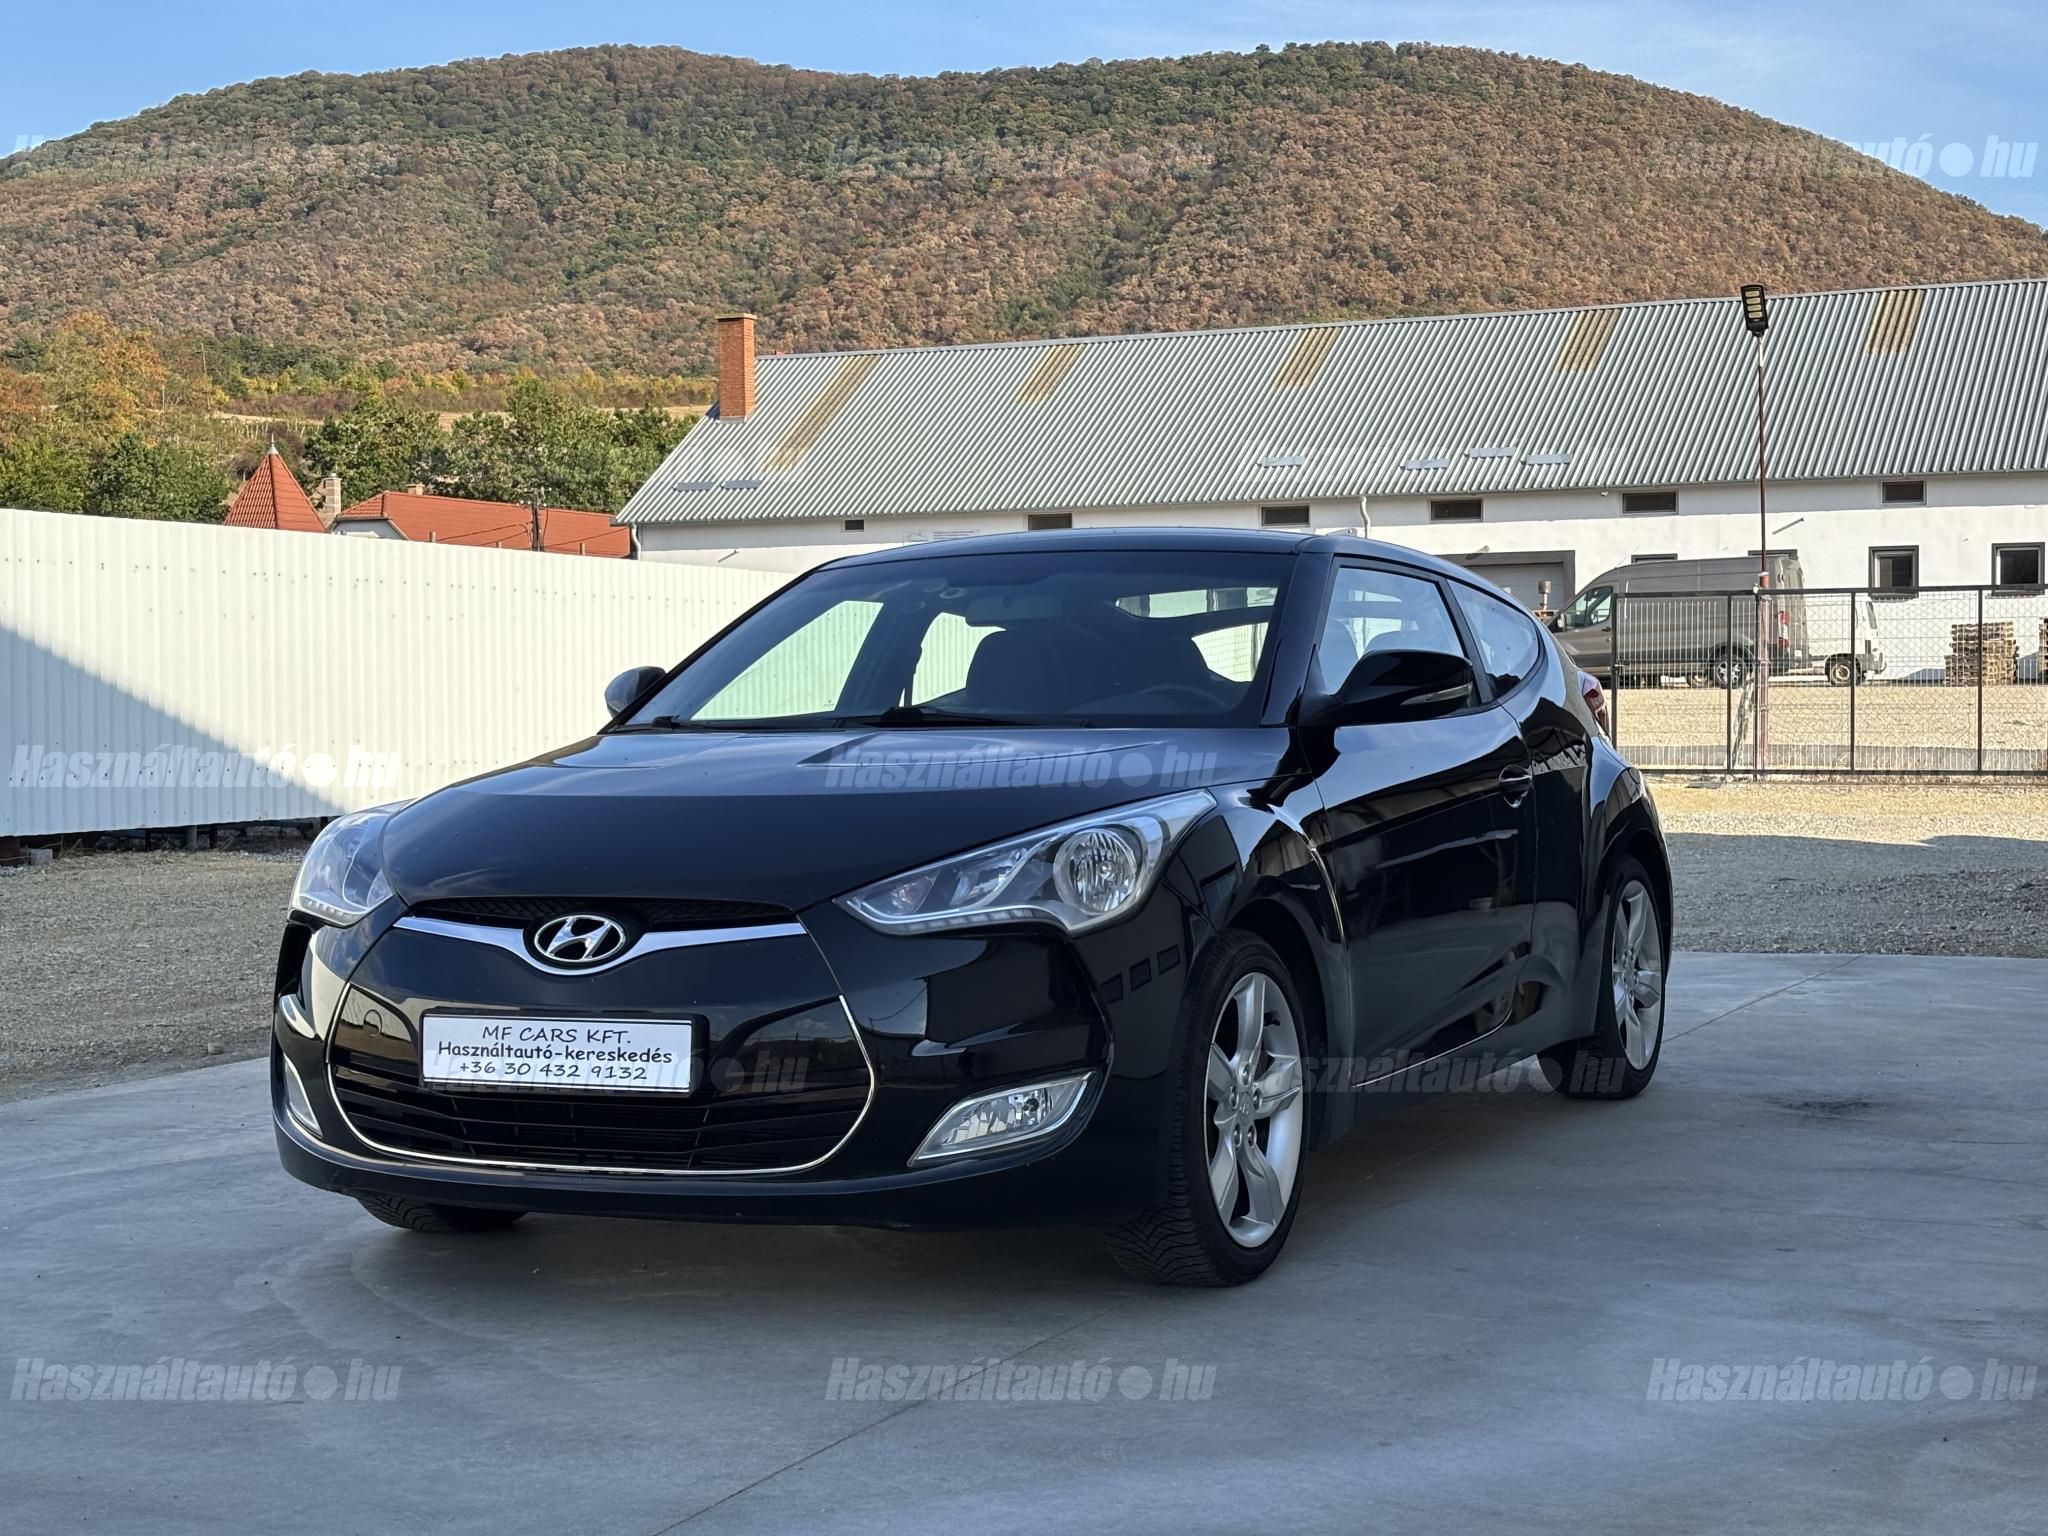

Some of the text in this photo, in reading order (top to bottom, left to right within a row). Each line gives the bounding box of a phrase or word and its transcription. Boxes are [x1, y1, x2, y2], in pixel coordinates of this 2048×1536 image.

[483, 1025, 631, 1044] MF CARS KFT.
[438, 1041, 672, 1064] Használtautó-kereskedés
[460, 1061, 647, 1081] +36 30 432 9132
